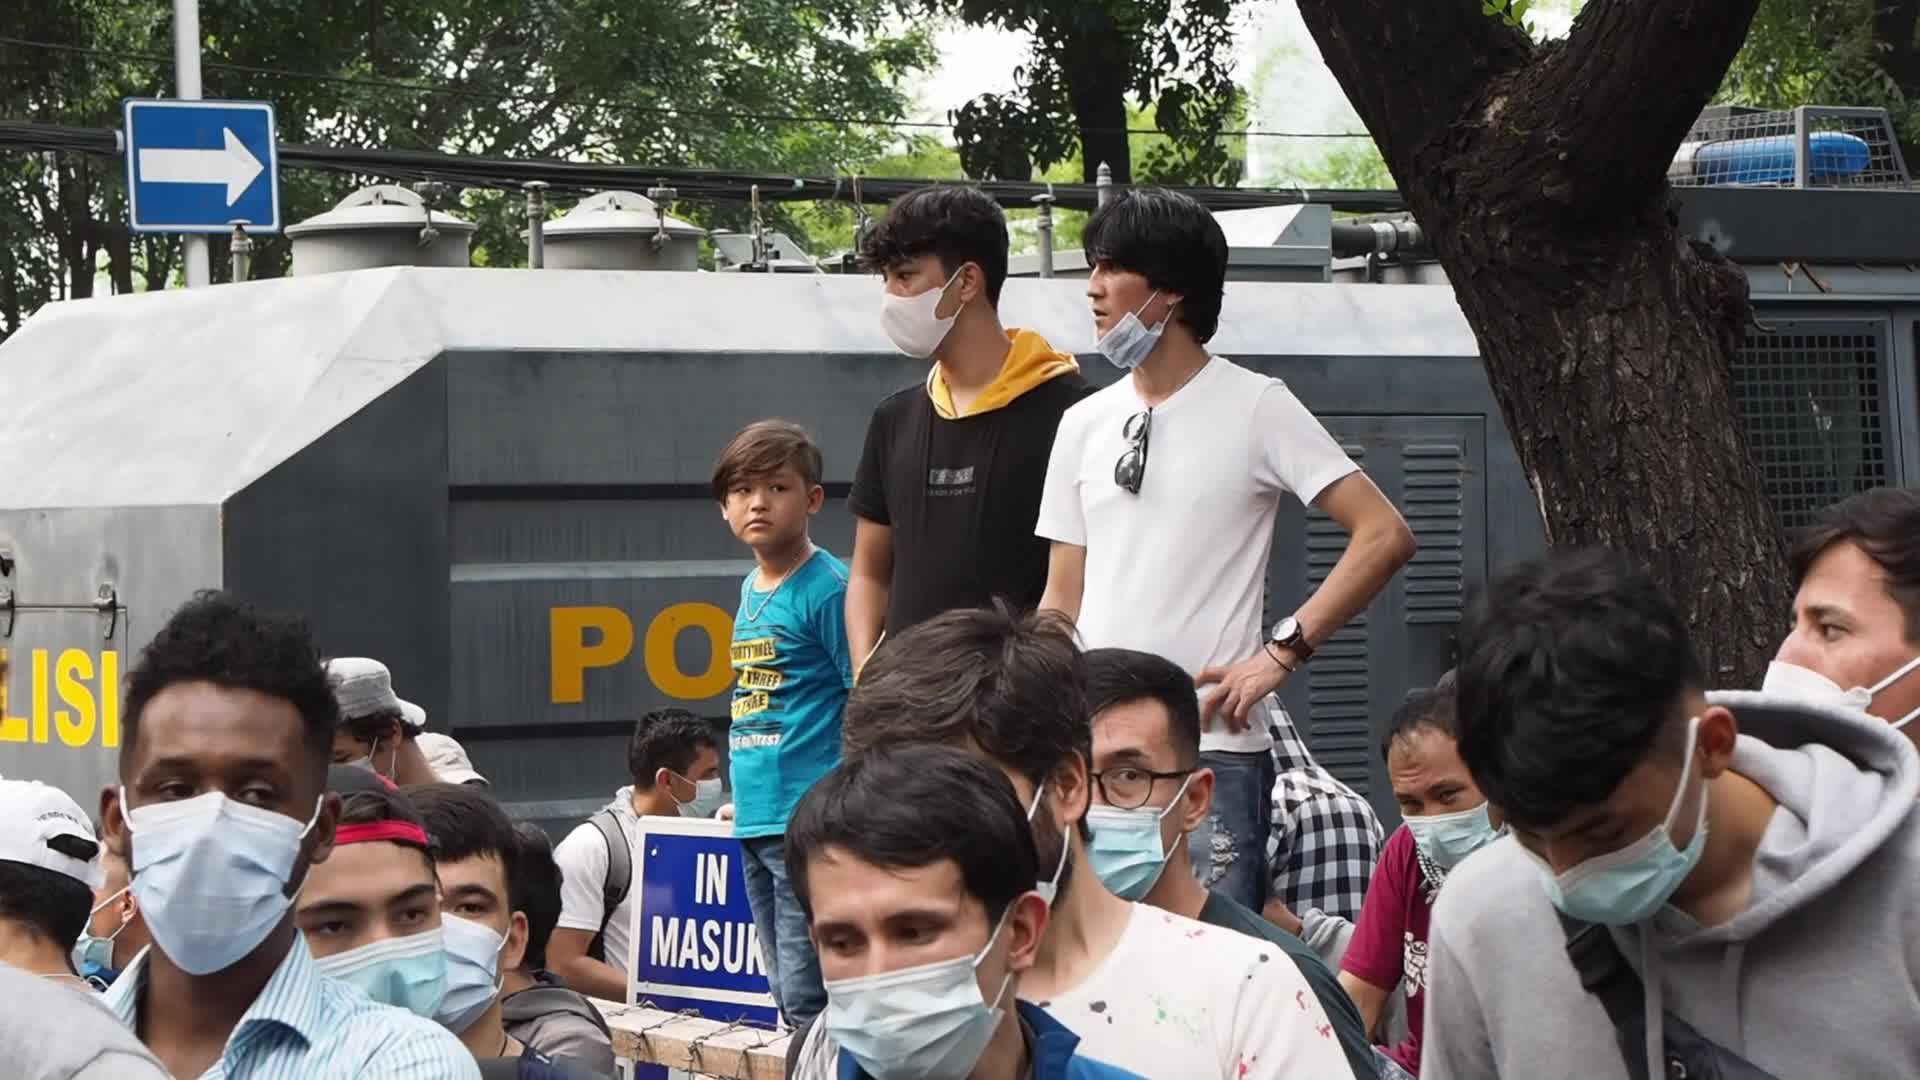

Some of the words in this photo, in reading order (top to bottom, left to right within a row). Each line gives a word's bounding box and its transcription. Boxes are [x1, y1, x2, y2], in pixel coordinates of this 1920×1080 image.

[0, 648, 119, 747] LISI
[695, 853, 729, 905] IN
[650, 915, 767, 976] MASUK
